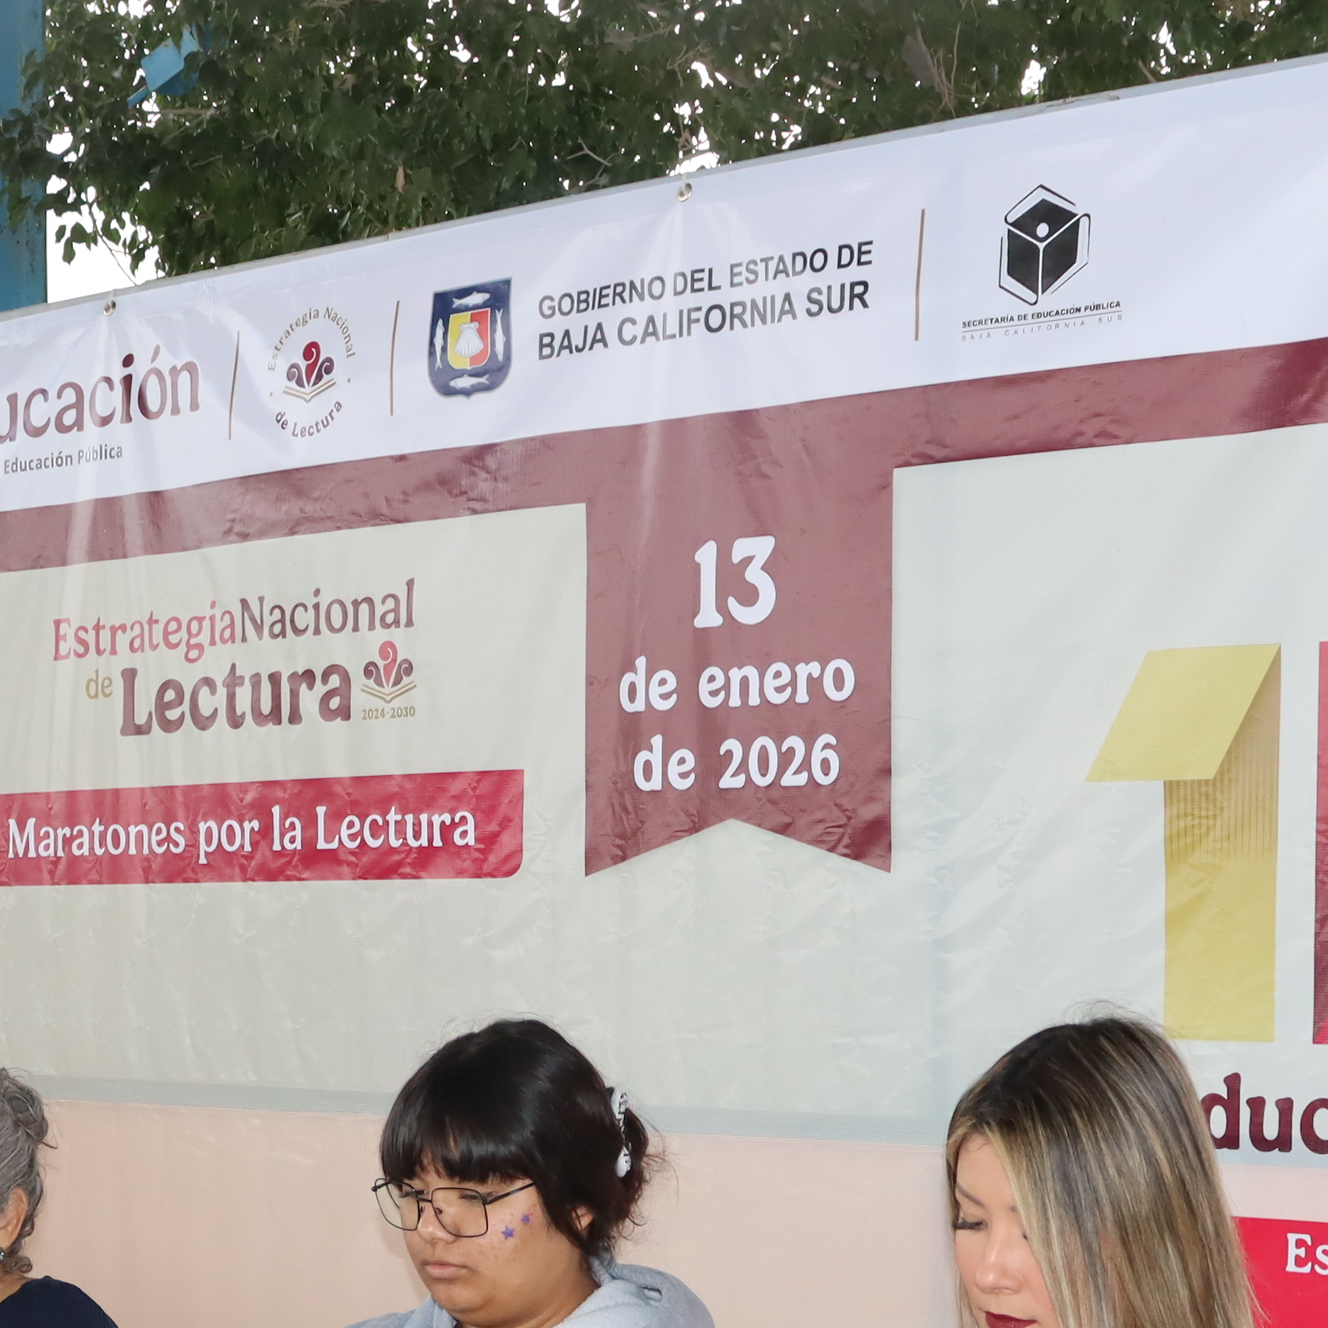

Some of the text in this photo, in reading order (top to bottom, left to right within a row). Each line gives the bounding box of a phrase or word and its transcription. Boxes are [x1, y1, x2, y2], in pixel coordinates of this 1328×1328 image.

[538, 240, 874, 320] GOBIERNO DEL ESTADO DE
[267, 306, 356, 371] Estrategia Nacional
[538, 279, 870, 361] BAJA CALIFORNIA SUR
[961, 314, 1123, 343] BAJA CALIFORNIA SUR
[962, 300, 1121, 329] SECRETARÍA DE EDUCACIÓN PÚBLICA
[275, 400, 343, 438] de Lectura
[3, 451, 73, 475] Educación
[77, 444, 123, 465] Pública
[693, 534, 777, 628] 13
[85, 661, 352, 737] de Lectura
[361, 706, 416, 720] 2024-2030
[619, 655, 856, 713] de enero
[633, 733, 841, 791] de 2026
[7, 804, 476, 865] Maratones por la Lectura
